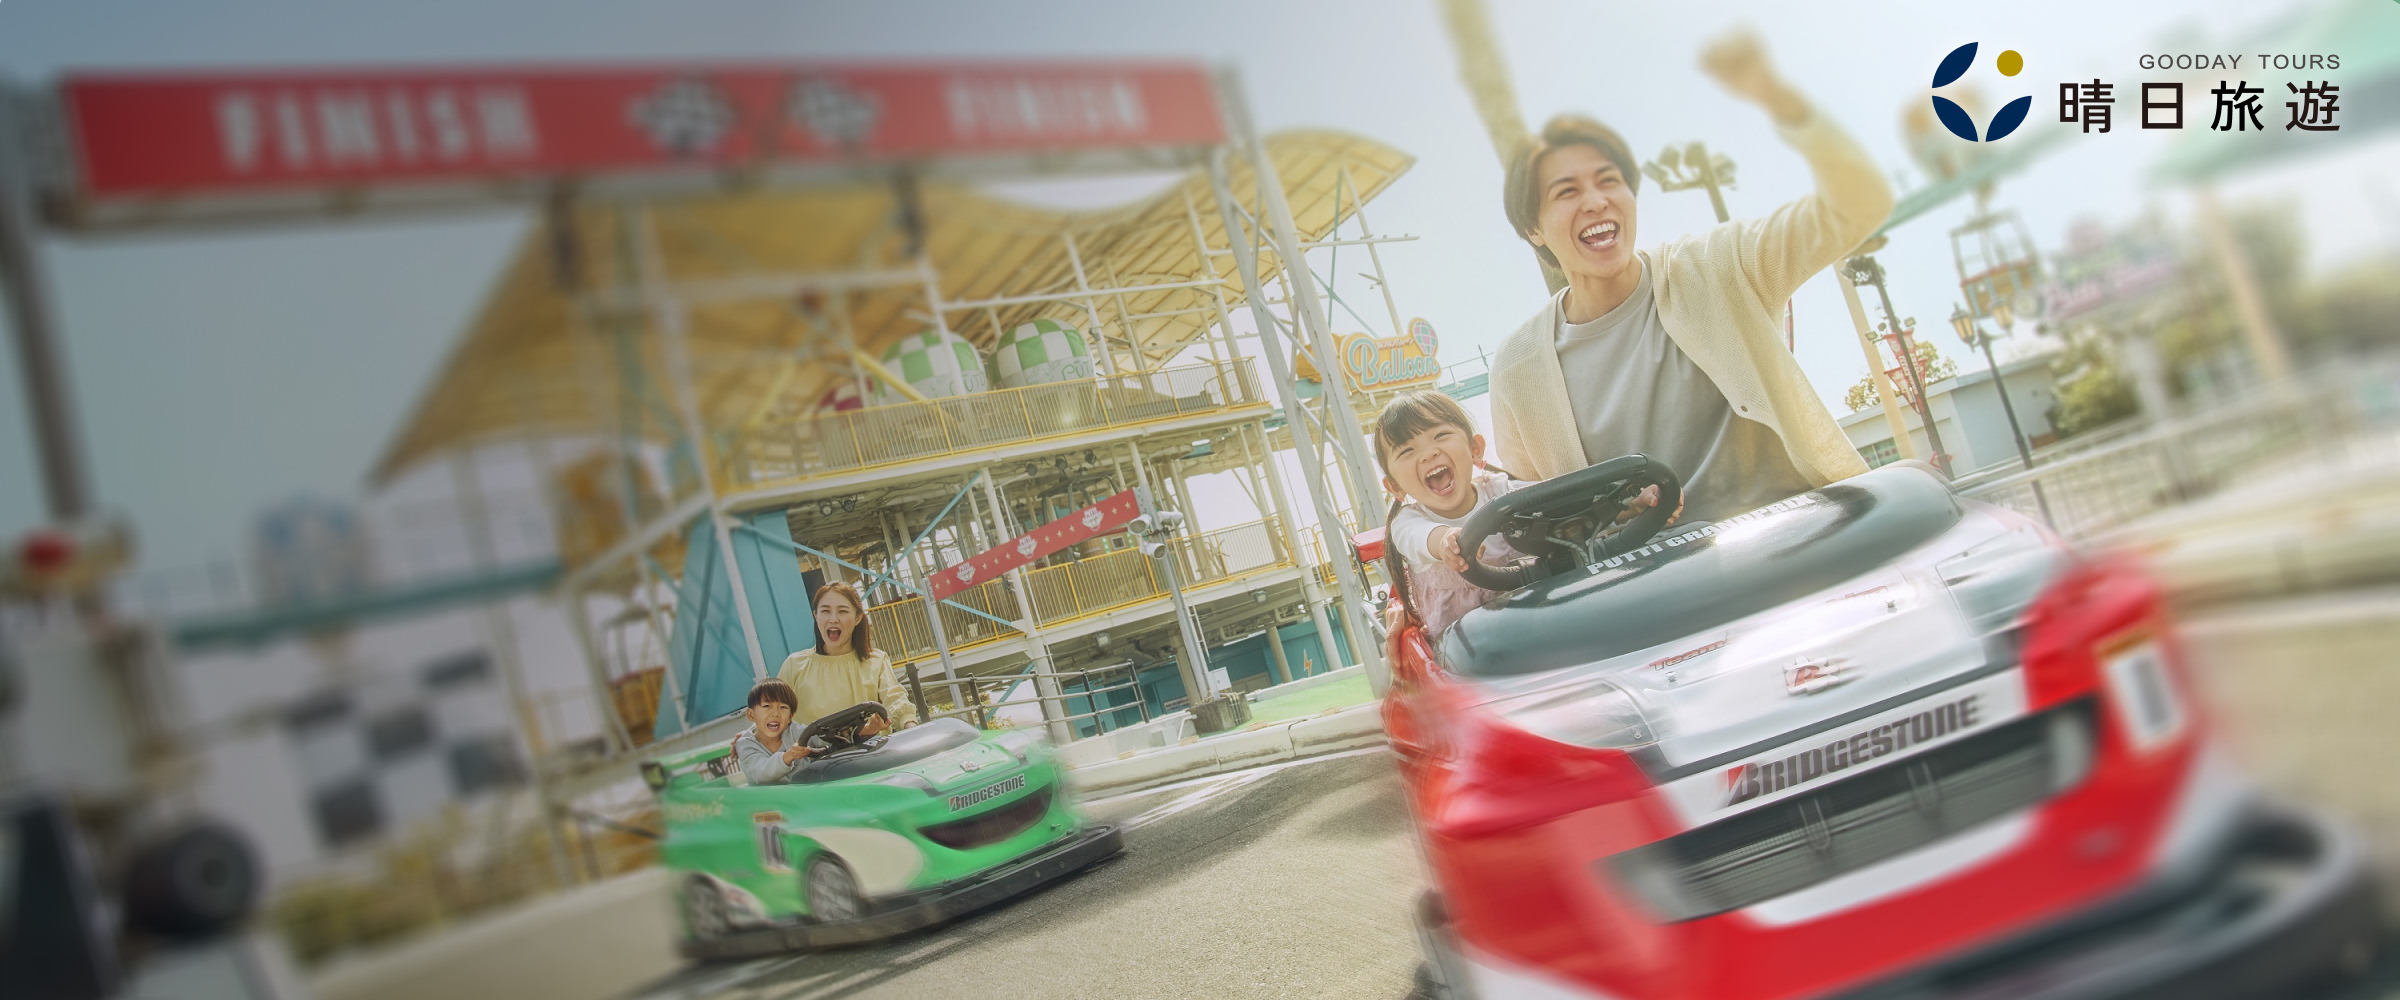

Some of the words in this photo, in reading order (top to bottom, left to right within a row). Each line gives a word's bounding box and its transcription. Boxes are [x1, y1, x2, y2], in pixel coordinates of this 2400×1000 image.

[214, 84, 542, 174] FINISH
[1348, 337, 1439, 385] Balloon
[1586, 542, 1664, 575] PUTTI
[1727, 693, 1981, 807] BRIDGESTONE
[950, 775, 1025, 812] BRIDGESTONE
